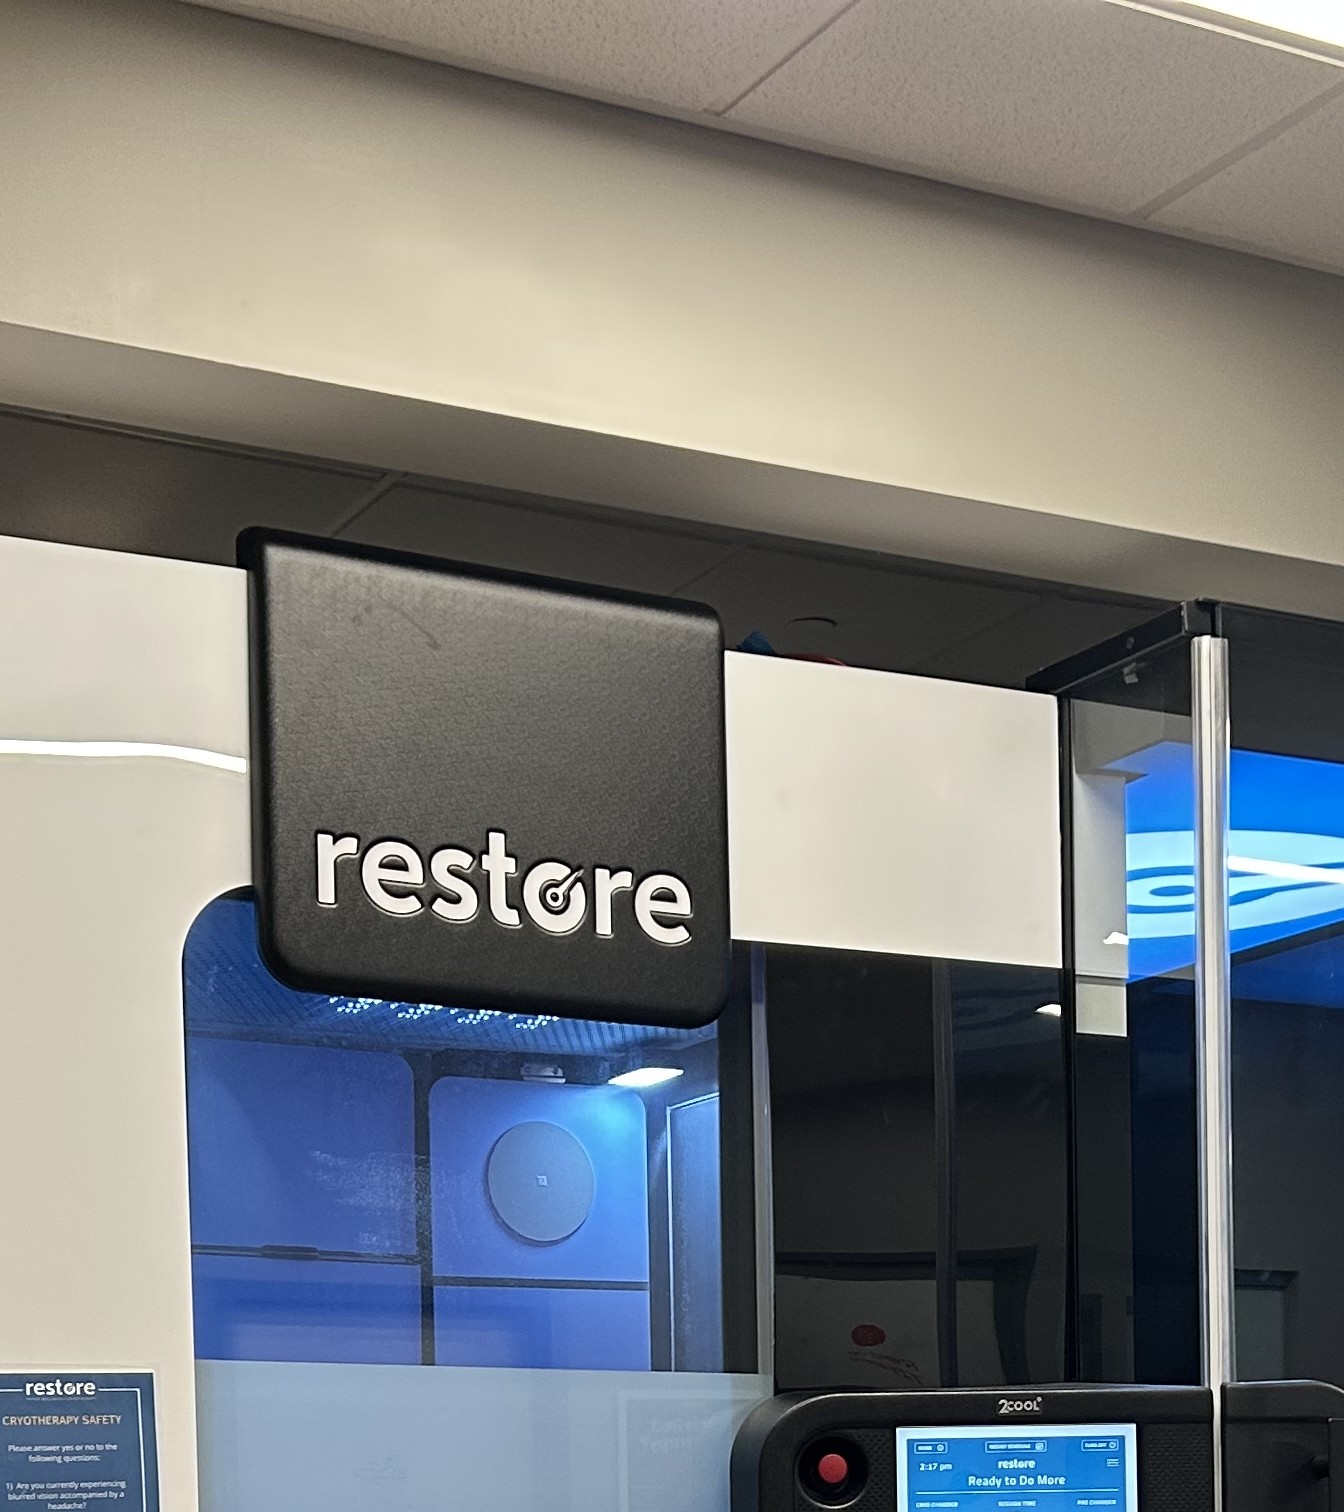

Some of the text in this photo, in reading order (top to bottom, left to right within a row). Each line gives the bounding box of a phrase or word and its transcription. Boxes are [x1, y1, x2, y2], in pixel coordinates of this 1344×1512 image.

[315, 831, 694, 945] restore
[25, 1379, 96, 1396] restore
[2, 1414, 122, 1426] CRYOTHERAPY SAFETY
[7, 1444, 32, 1452] Please
[61, 1445, 74, 1454] yes
[28, 1455, 62, 1463] following
[997, 1459, 1036, 1469] restore
[939, 1463, 953, 1472] pm
[30, 1483, 45, 1491] you
[45, 1481, 79, 1490] currently
[79, 1481, 126, 1489] experiencing
[968, 1475, 1066, 1488] Ready to Do More
[59, 1491, 108, 1500] accompanied
[108, 1491, 118, 1499] by
